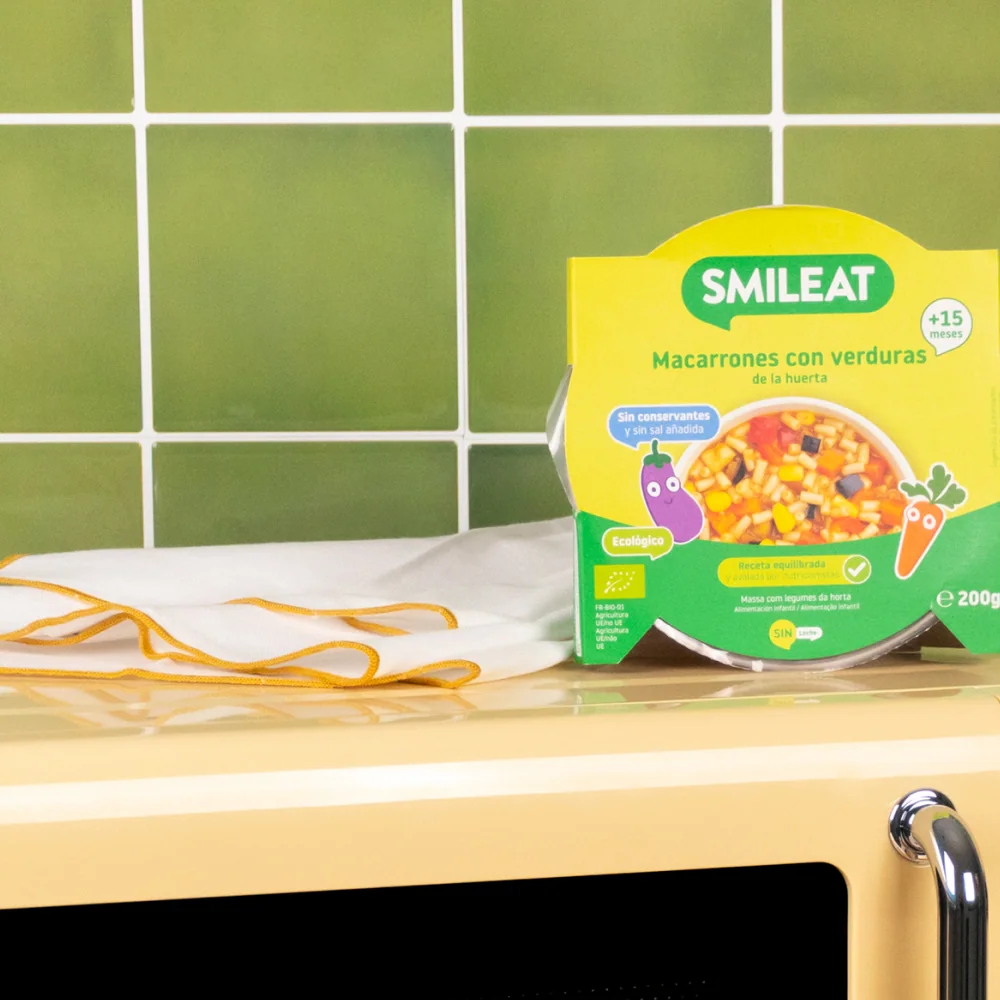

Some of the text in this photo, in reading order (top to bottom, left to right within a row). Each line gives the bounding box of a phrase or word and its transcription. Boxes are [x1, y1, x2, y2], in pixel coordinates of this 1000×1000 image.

[702, 266, 875, 304] SMILEAT
[929, 310, 963, 326] +15
[930, 330, 963, 338] meses
[652, 346, 927, 369] Macarrones con verduras
[752, 373, 827, 384] de la huerta
[618, 411, 710, 422] Sin conservantes
[625, 424, 704, 438] y sin sal añadida
[301, 511, 478, 551] cecotec
[612, 535, 665, 548] Ecológico
[738, 560, 826, 571] Receta equilibrada
[741, 595, 765, 603] Massa
[785, 594, 817, 604] legumes
[830, 593, 852, 601] horta
[958, 590, 1000, 609] 200g
[774, 629, 793, 638] SIN
